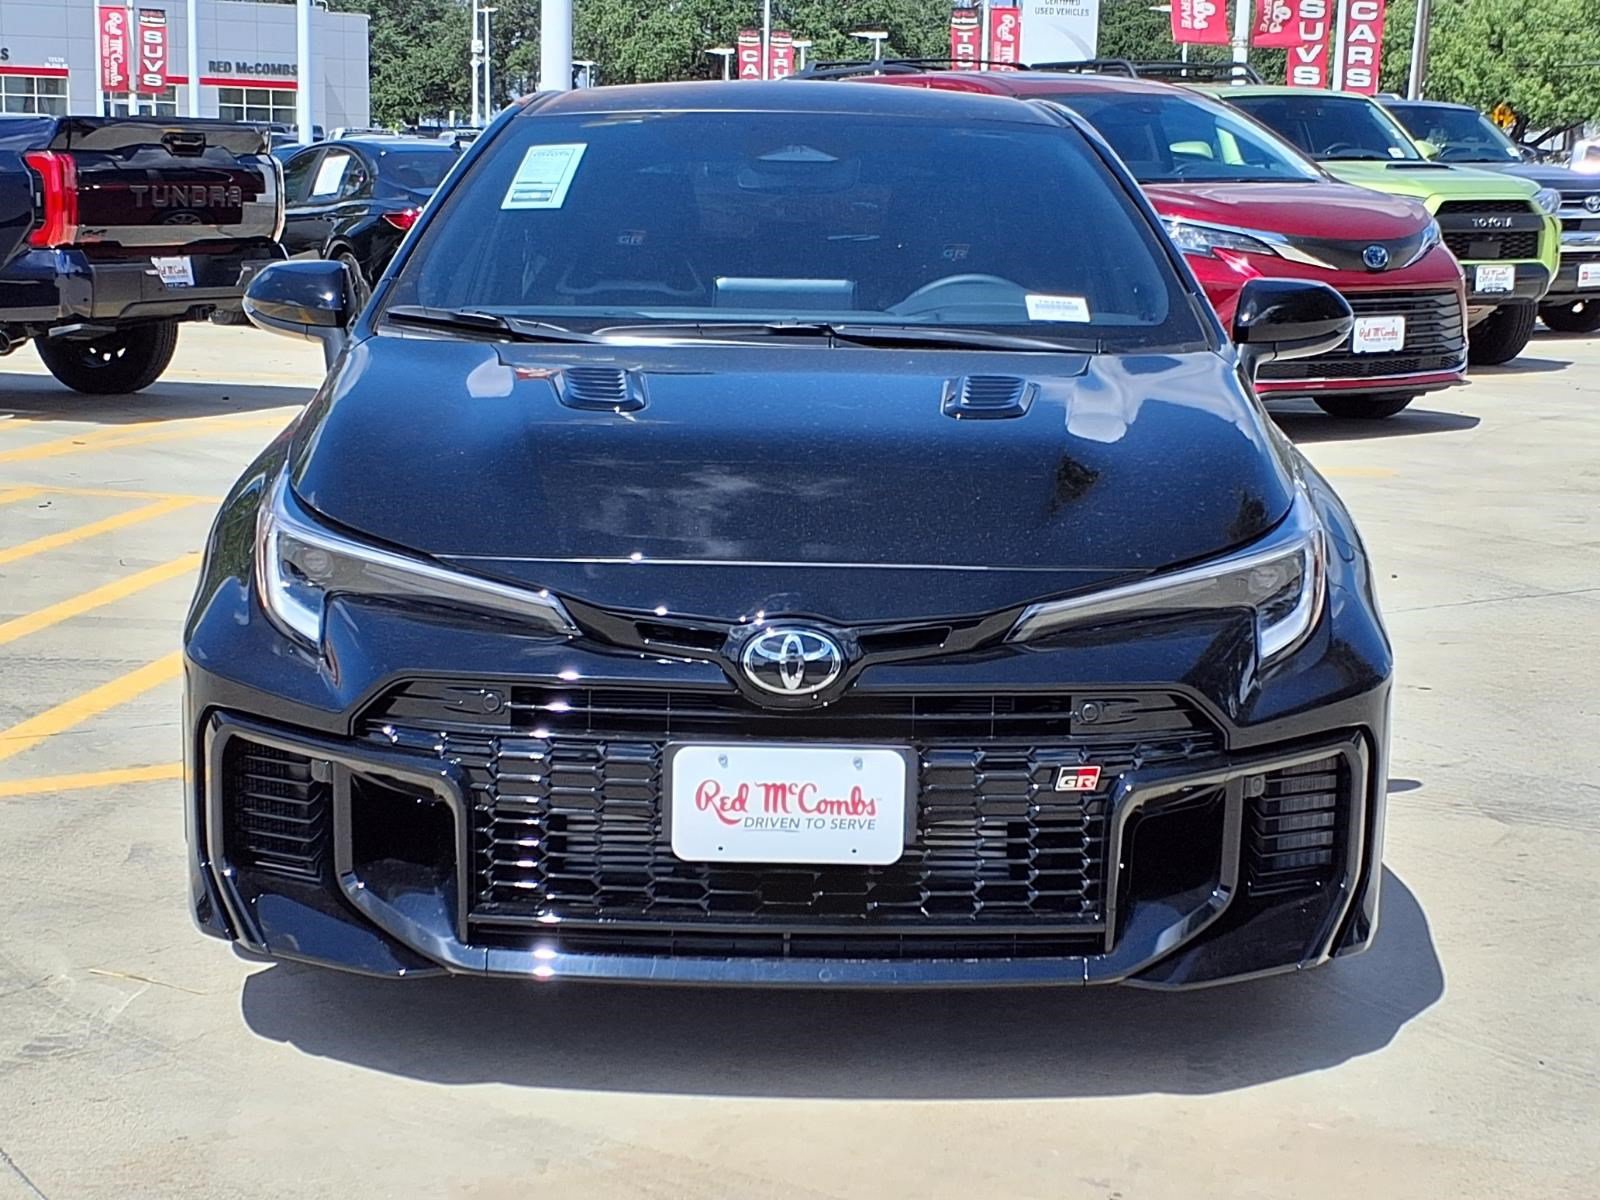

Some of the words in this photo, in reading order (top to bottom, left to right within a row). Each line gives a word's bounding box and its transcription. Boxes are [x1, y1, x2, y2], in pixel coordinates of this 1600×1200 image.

[1034, 7, 1055, 16] USED
[1056, 8, 1090, 17] VEHICLES
[996, 14, 1016, 42] Red
[1293, 0, 1326, 85] SUVS
[1346, 1, 1378, 87] CARS
[142, 30, 164, 87] SUVS
[208, 60, 232, 73] RED
[235, 62, 298, 76] McCOMBS
[741, 49, 760, 80] CA
[129, 185, 242, 207] TUNDRA
[1471, 217, 1512, 228] TOYOTA
[1059, 775, 1097, 788] GR
[695, 779, 750, 826] Red
[754, 783, 876, 817] McCombs
[743, 816, 800, 829] DRIVEN
[805, 817, 826, 830] TO
[829, 818, 876, 831] SERVE
